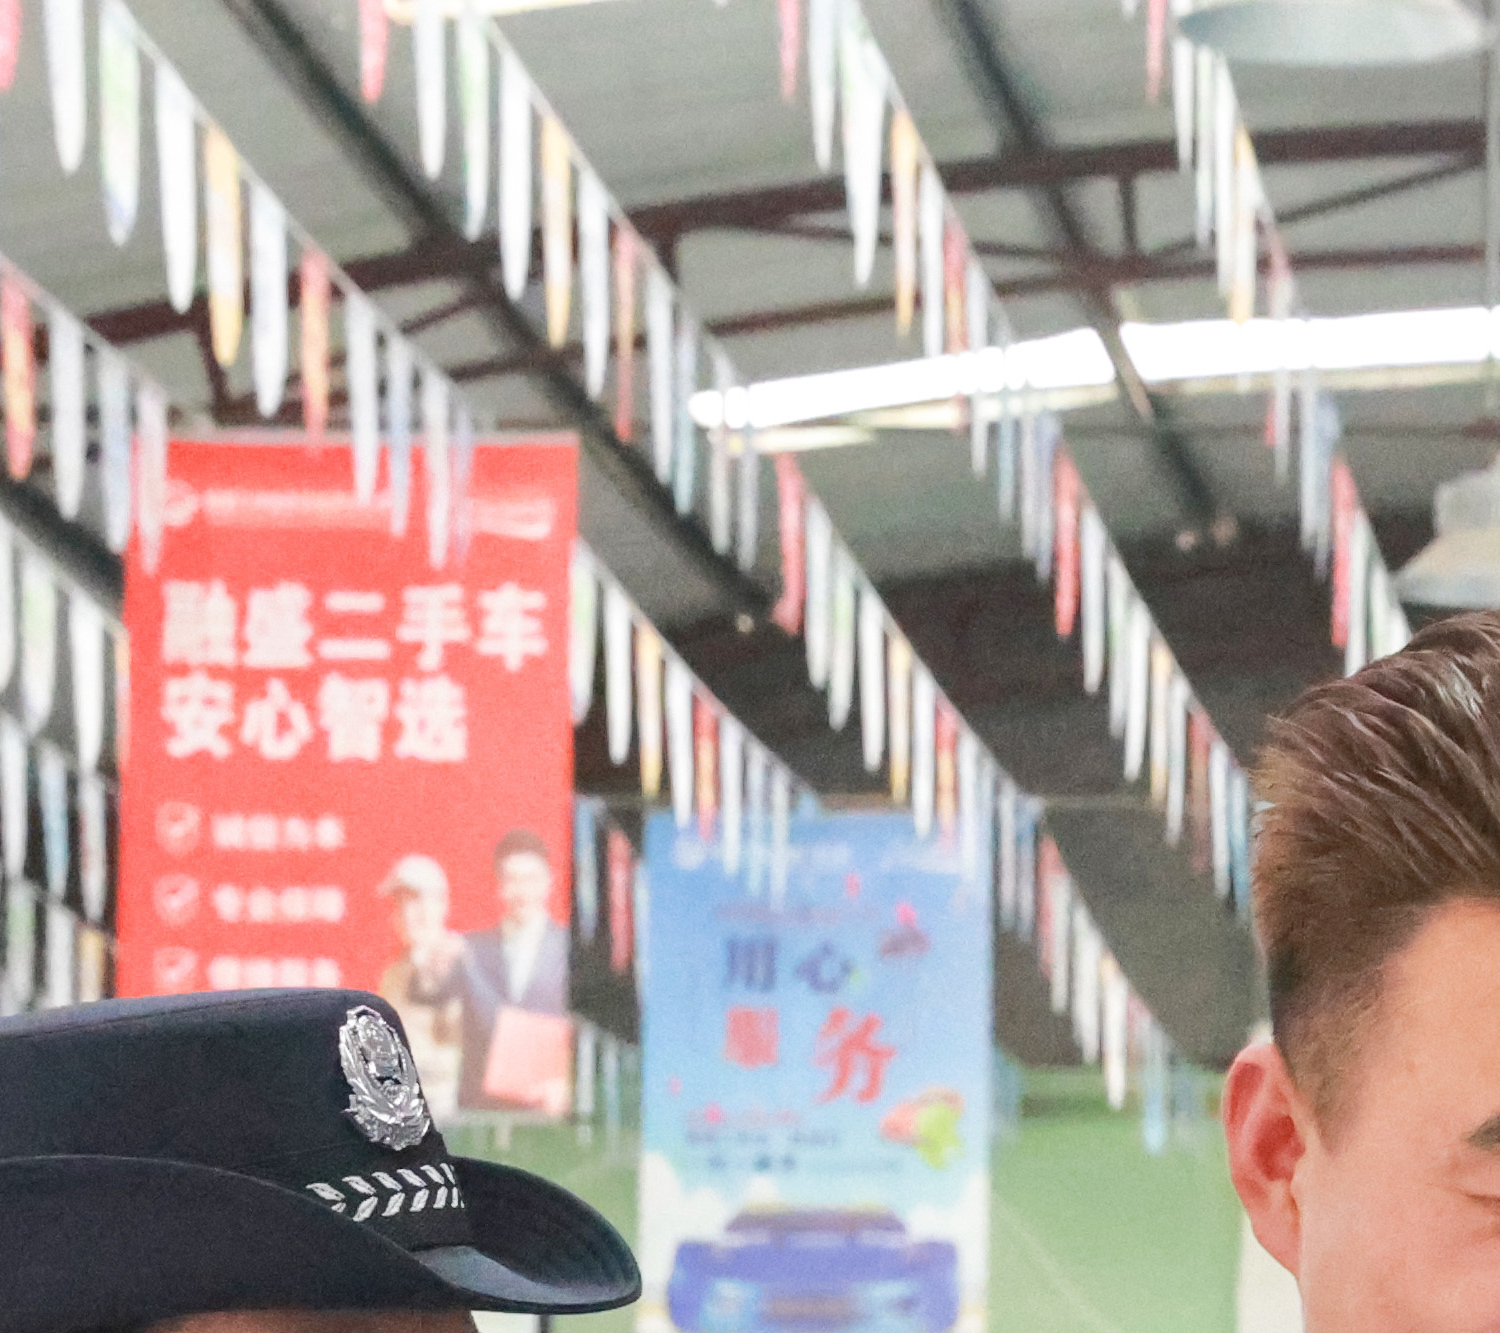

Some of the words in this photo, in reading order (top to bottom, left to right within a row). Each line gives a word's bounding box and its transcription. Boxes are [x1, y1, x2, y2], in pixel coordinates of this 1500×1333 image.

[160, 579, 550, 673] 融盛二手车
[160, 672, 469, 762] 安心智选
